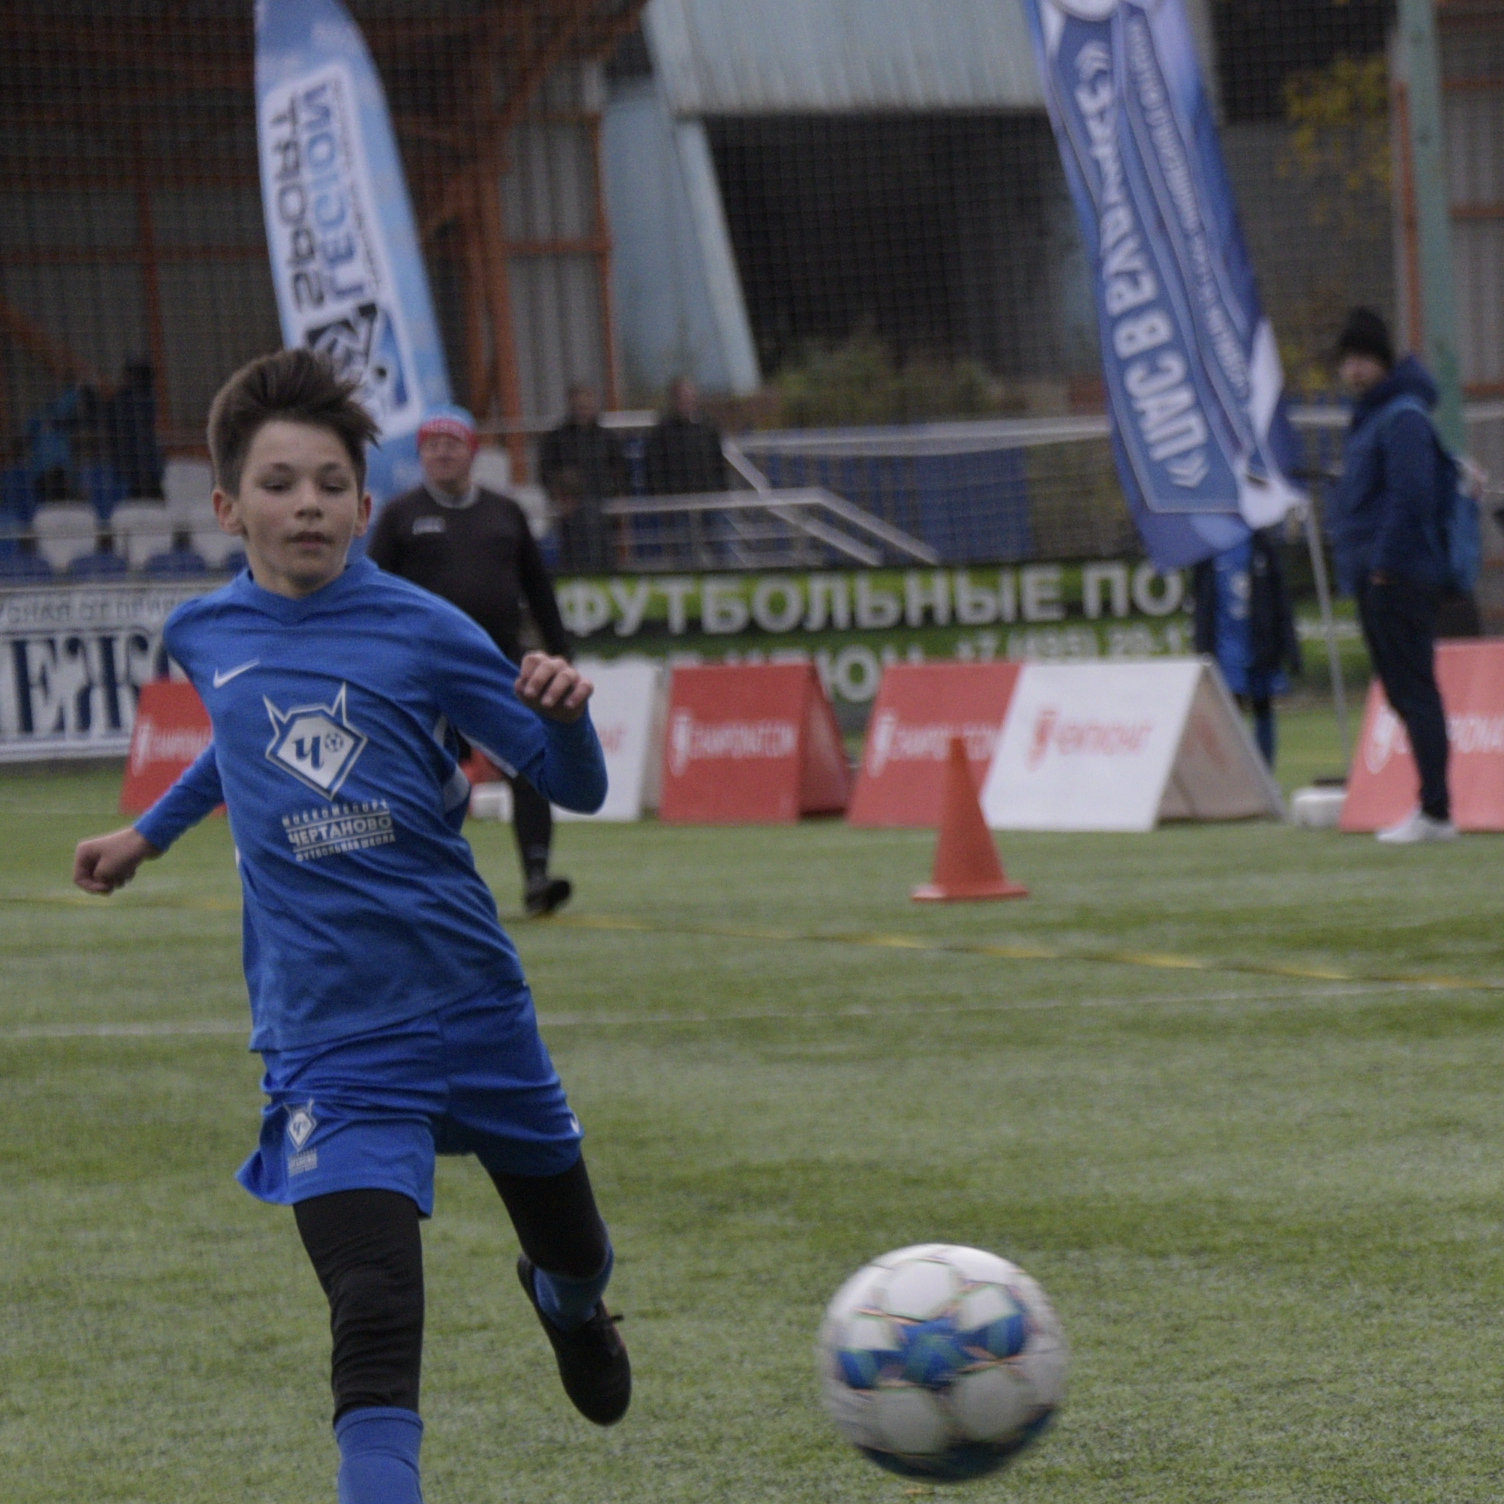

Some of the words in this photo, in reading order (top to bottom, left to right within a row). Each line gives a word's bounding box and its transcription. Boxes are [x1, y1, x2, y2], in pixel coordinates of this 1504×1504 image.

[559, 565, 1065, 636] ФУТБОЛЬНЫЕ
[1081, 563, 1193, 617] ПО
[289, 816, 393, 846] ЧЕРТАНОВО
